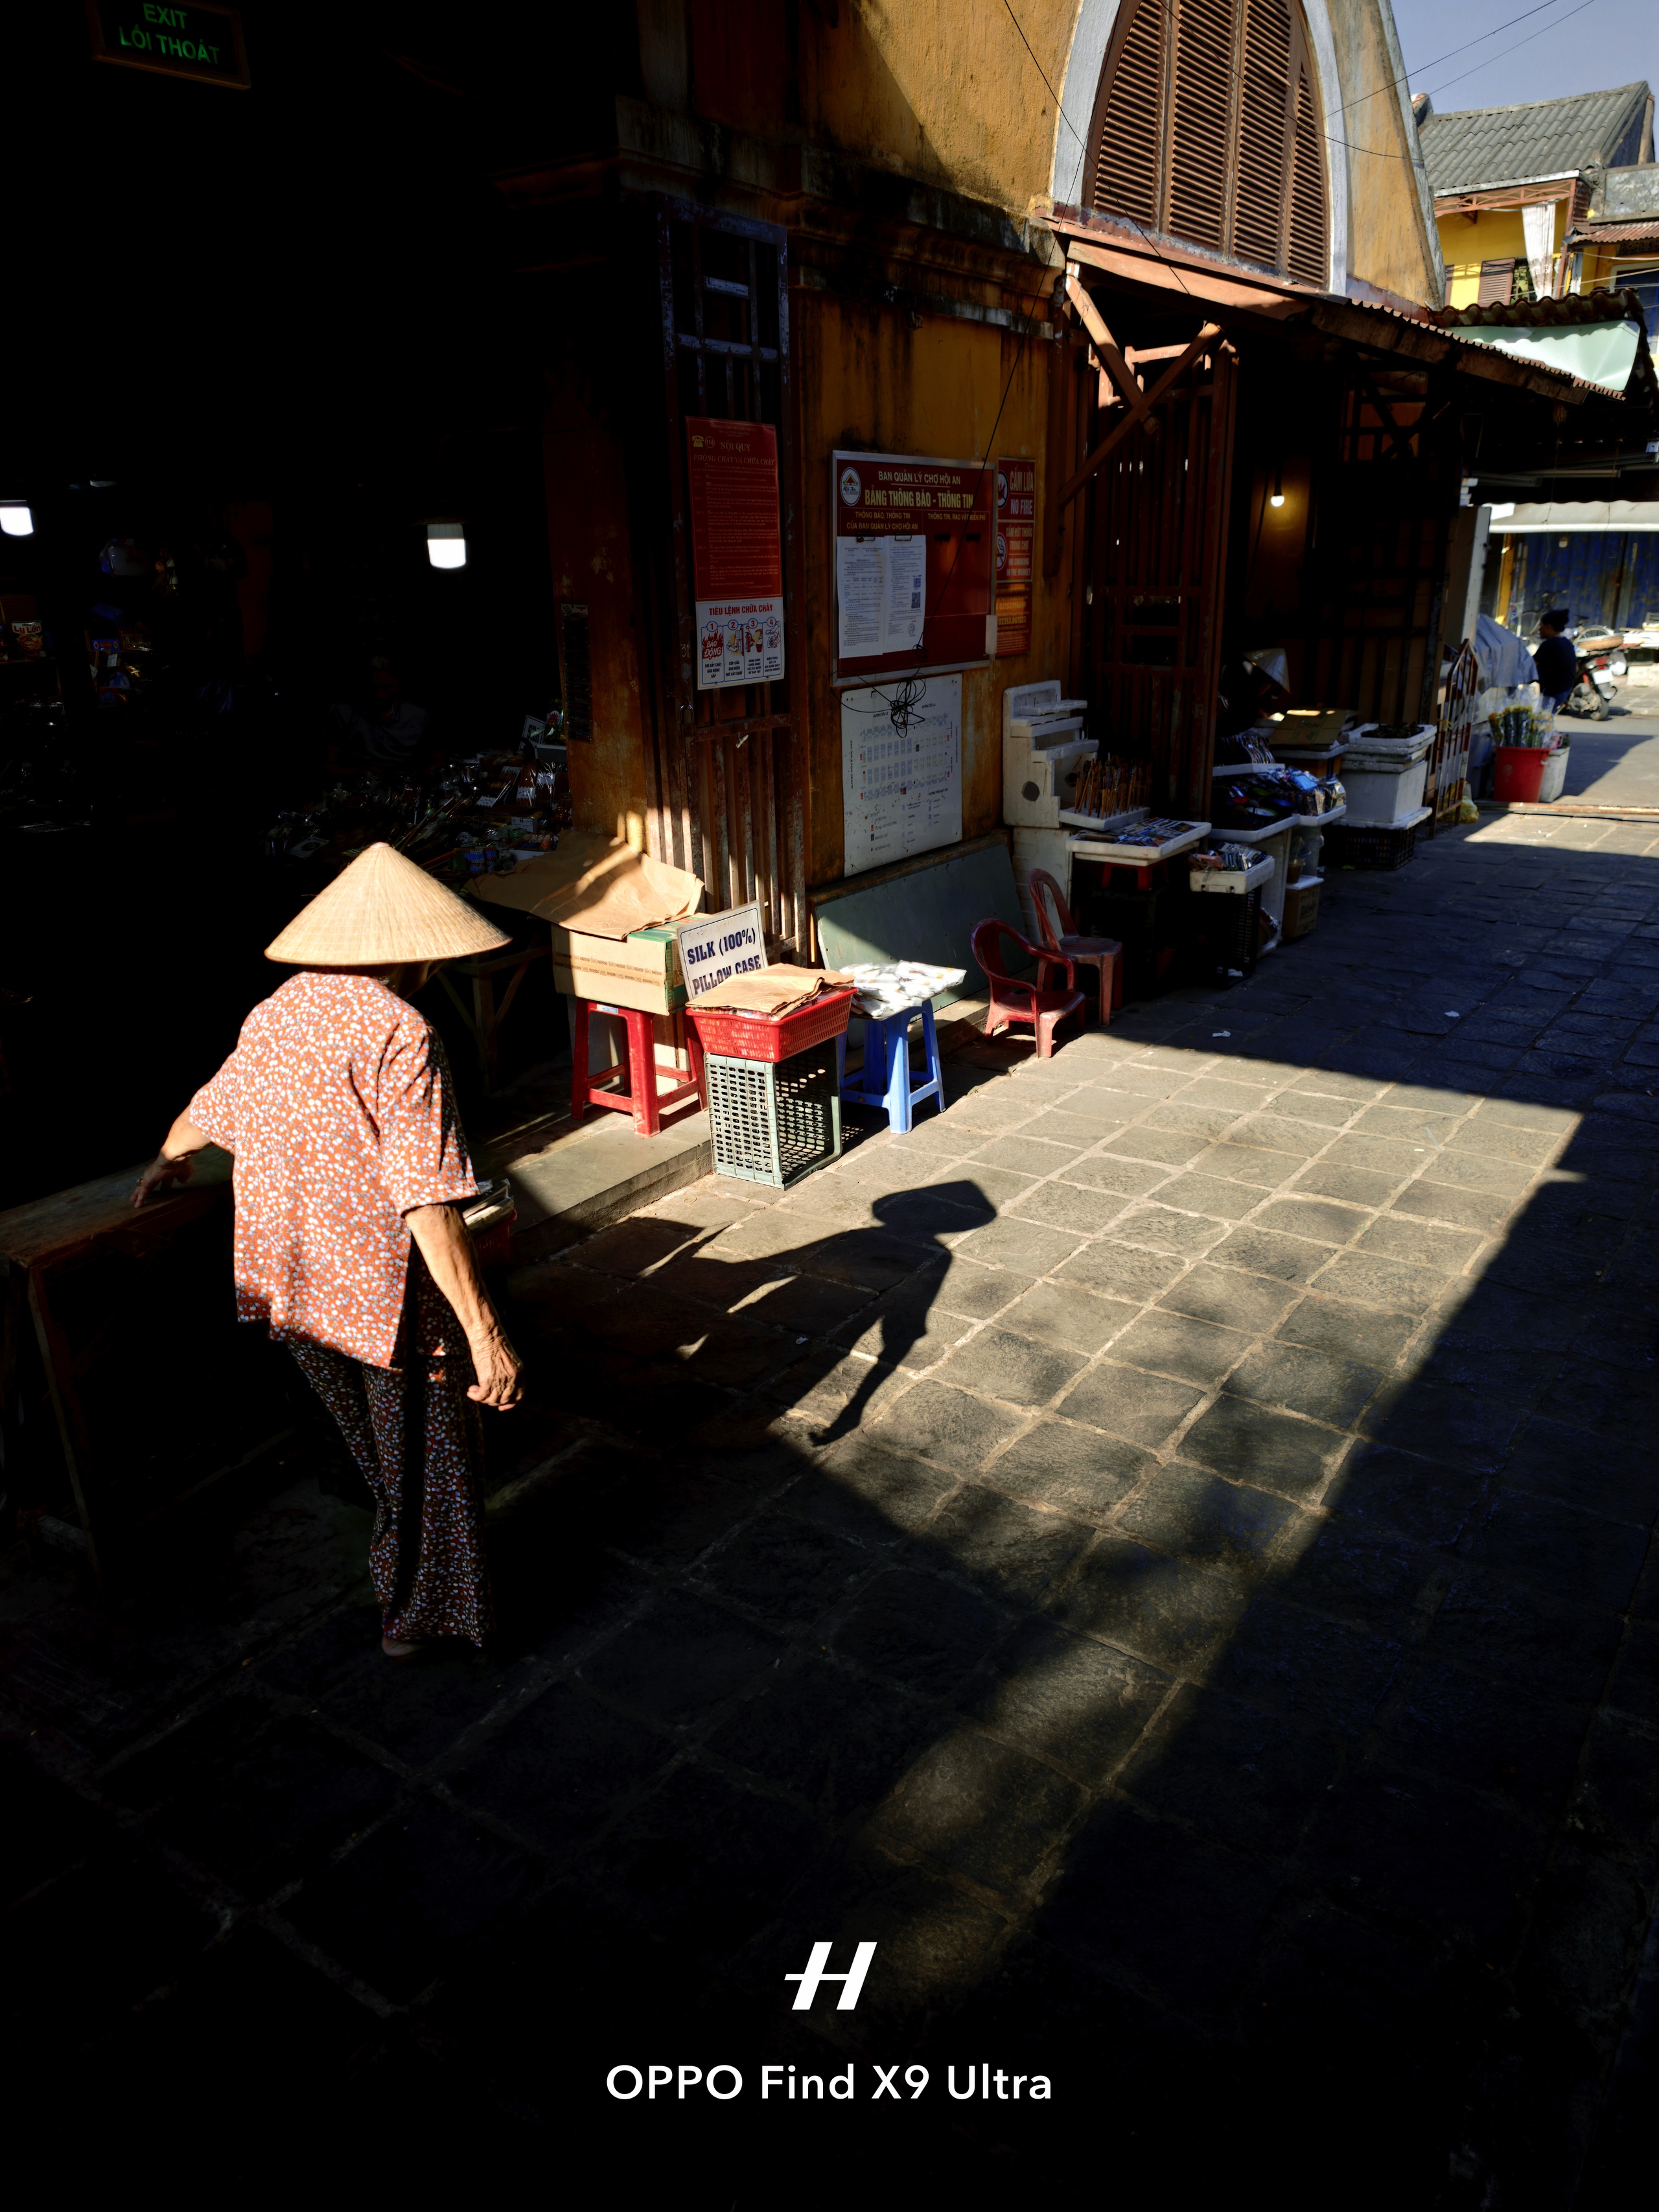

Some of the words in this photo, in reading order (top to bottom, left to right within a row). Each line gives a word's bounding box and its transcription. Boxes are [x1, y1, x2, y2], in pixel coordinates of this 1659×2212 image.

[143, 3, 187, 30] EXIT
[119, 24, 152, 51] LỐI
[156, 34, 220, 65] THOÁT
[721, 440, 734, 452] NỘI
[736, 443, 750, 452] QUY
[878, 471, 892, 481] BAN
[894, 469, 912, 482] QUẢN
[914, 471, 922, 483] LÝ
[924, 473, 938, 485] CHỢ
[940, 473, 950, 485] HỘI
[952, 476, 960, 484] AN
[1010, 465, 1022, 491] CẤM
[1024, 465, 1034, 491] LỬA
[864, 485, 887, 506] BẢNG
[888, 488, 914, 506] THÔNG
[916, 489, 931, 507] BÁO
[938, 489, 961, 508] THÔNG
[963, 494, 973, 509] TIN
[1011, 498, 1019, 515] NO
[1020, 499, 1032, 515] FIRE
[870, 520, 884, 529] QUẢN
[892, 522, 902, 530] CHỢ
[709, 607, 723, 615] TIÊU
[725, 605, 740, 616] LỆNH
[742, 604, 757, 613] CHỮA
[759, 603, 772, 612] CHÁY
[14, 625, 25, 634] Ly
[27, 625, 41, 633] Lớn
[704, 647, 721, 658] ĐỘNG
[687, 940, 715, 965] SILK
[719, 927, 756, 957] (100%)
[691, 965, 732, 995] PILLOW
[735, 955, 761, 974] CASE
